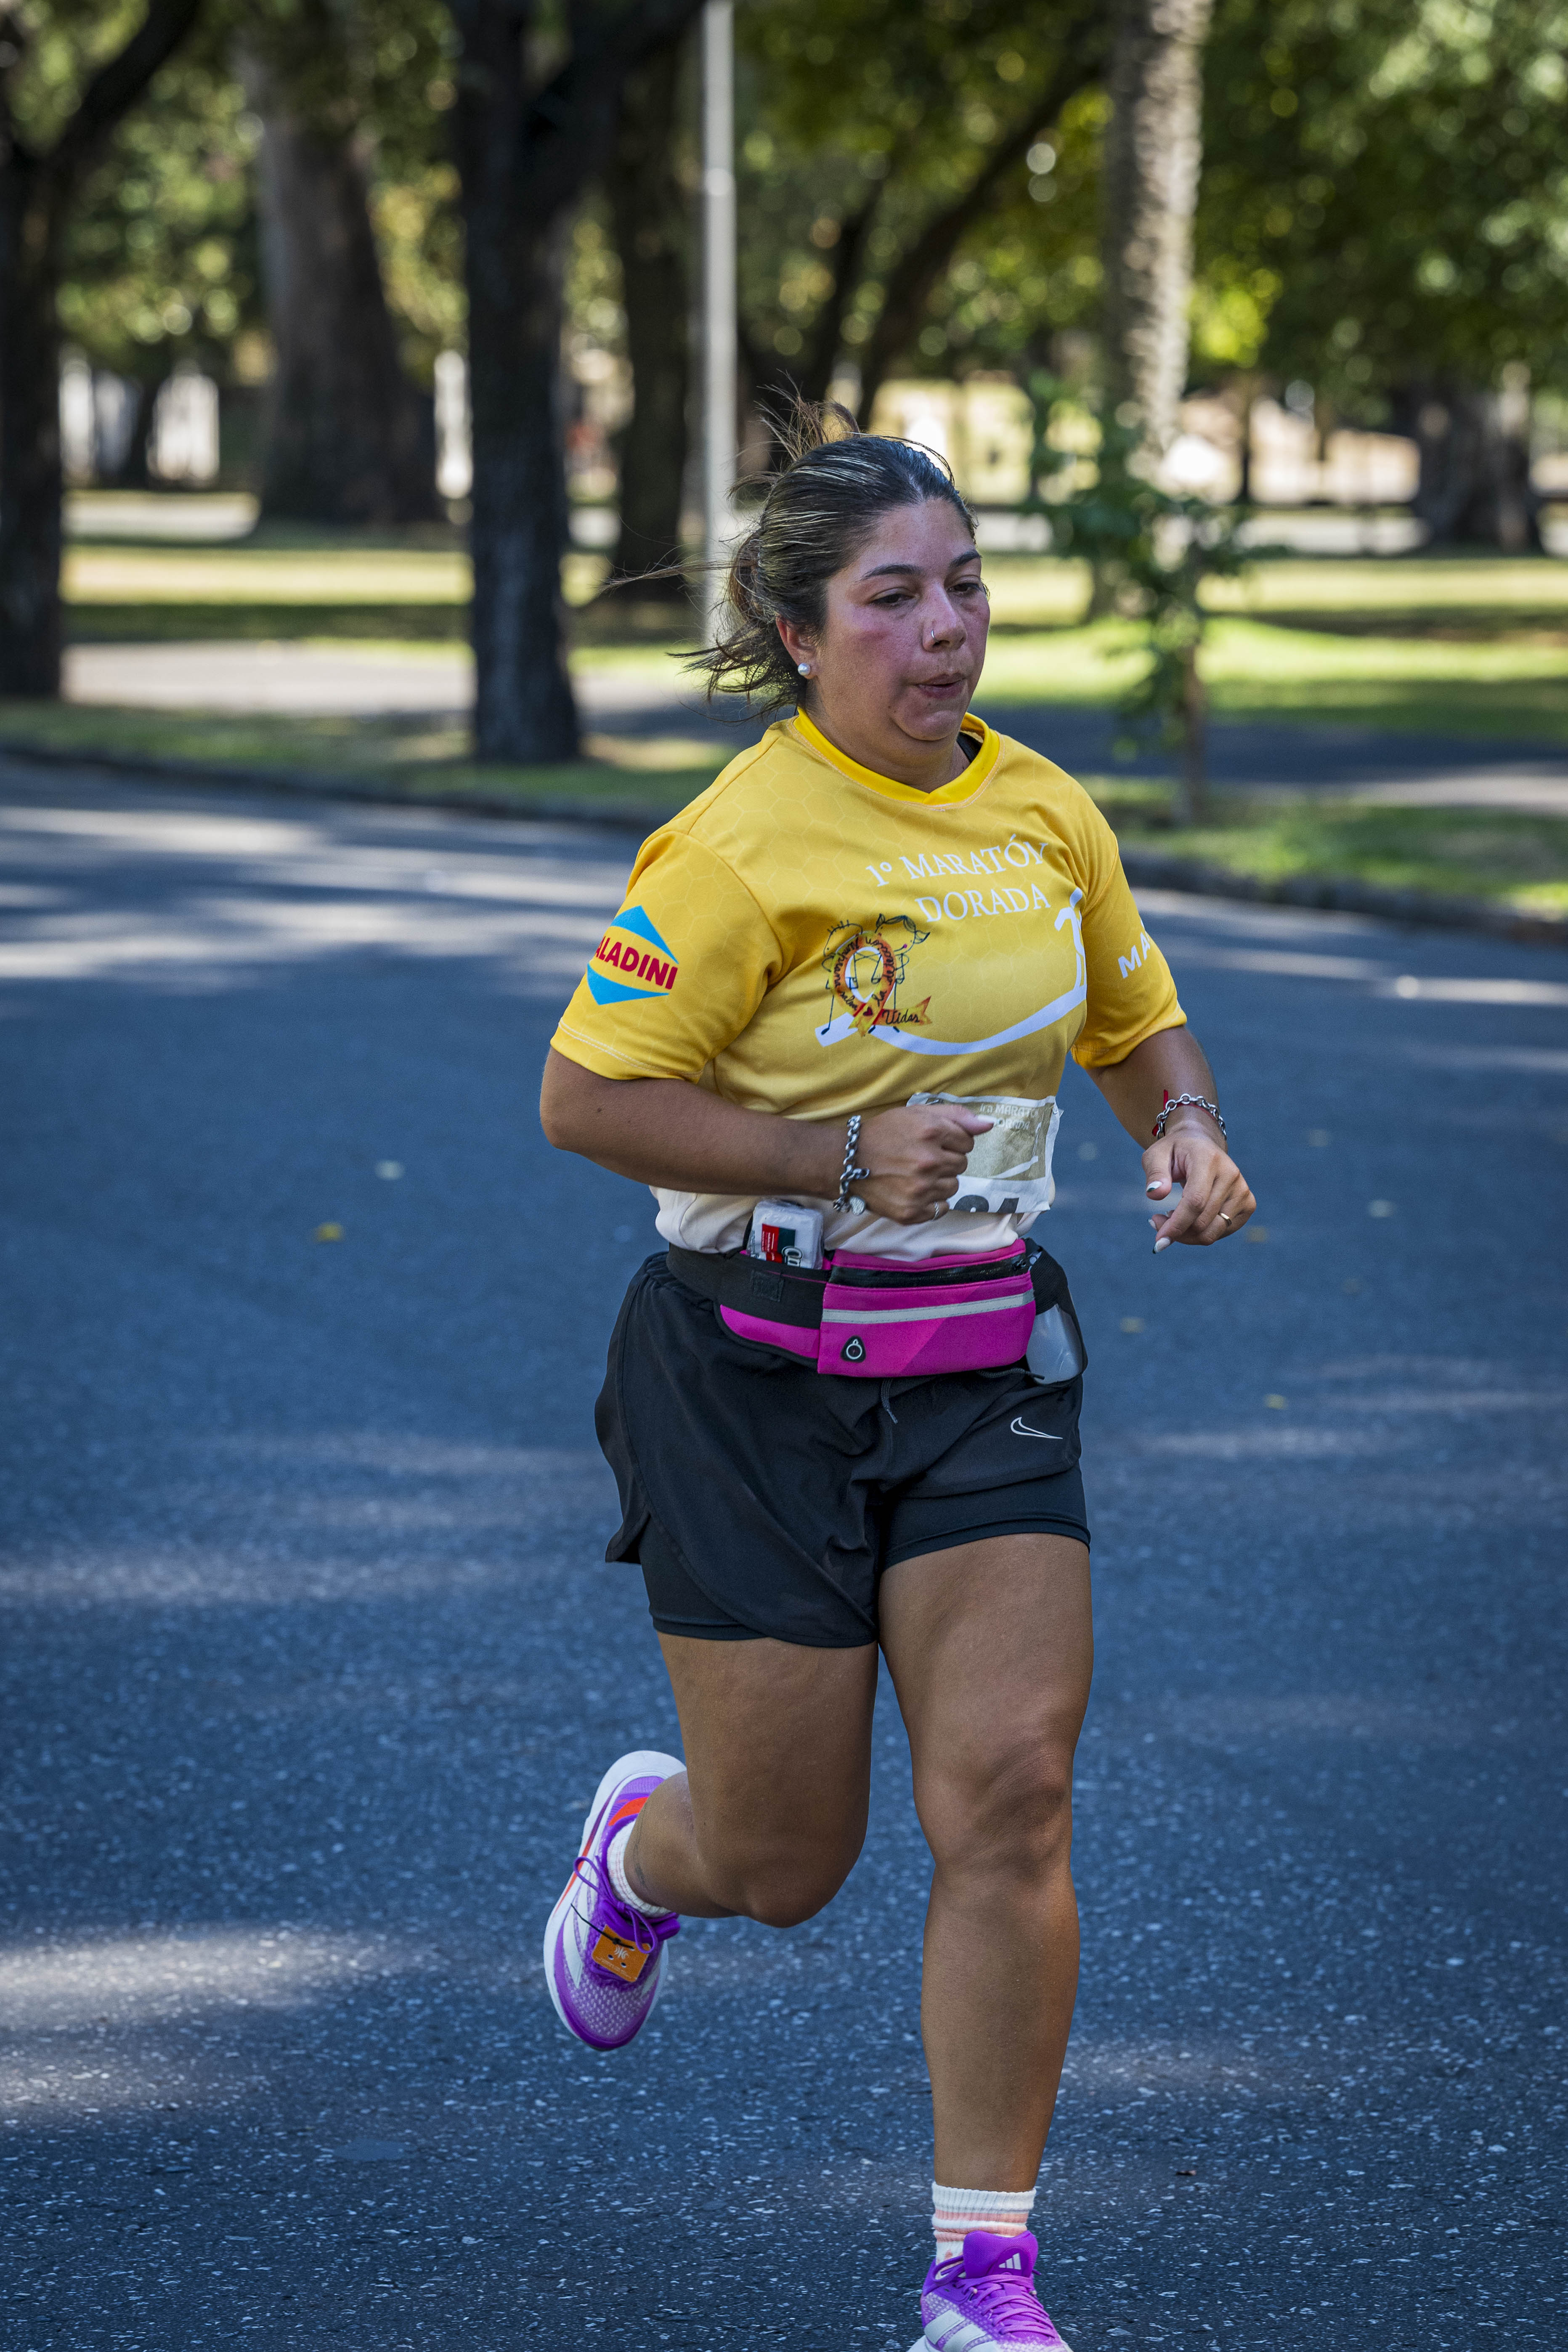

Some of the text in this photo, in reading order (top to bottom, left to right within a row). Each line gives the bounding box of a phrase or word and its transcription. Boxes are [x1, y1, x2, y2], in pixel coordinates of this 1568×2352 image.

[899, 833, 1048, 880] MARATÓN
[915, 883, 1051, 923] DORADA
[881, 1008, 920, 1024] Vidas
